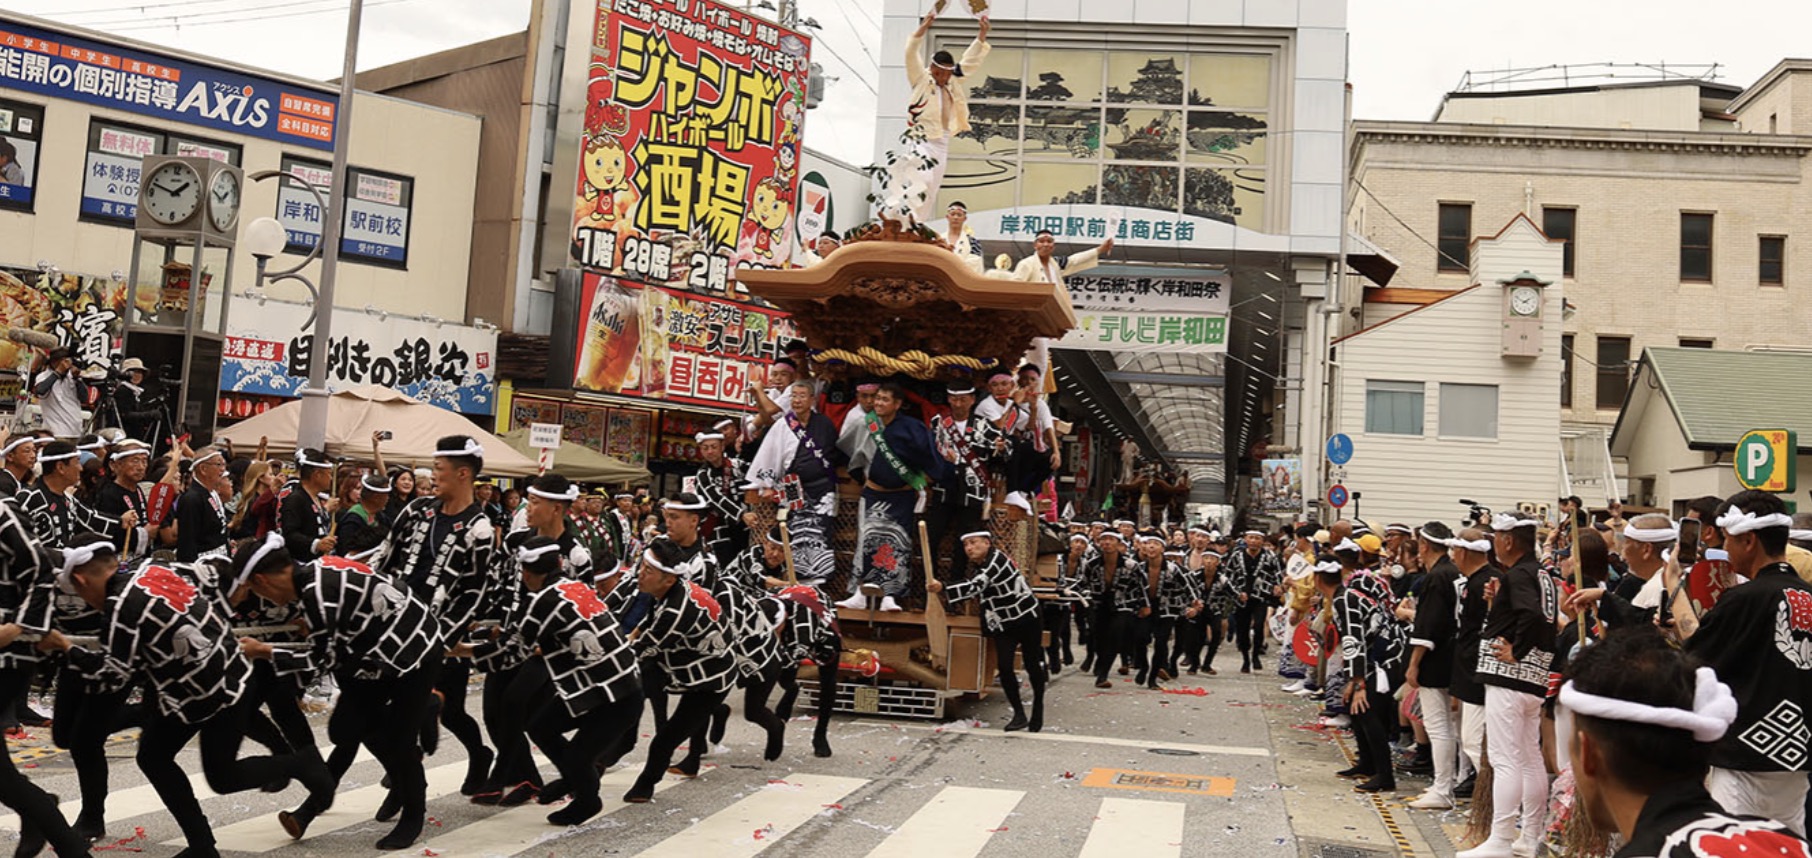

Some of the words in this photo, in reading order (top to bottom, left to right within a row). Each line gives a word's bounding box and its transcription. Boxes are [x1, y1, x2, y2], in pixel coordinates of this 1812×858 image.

[693, 1, 752, 36] ハイボール
[756, 23, 778, 46] 焼酎
[7, 34, 49, 53] 小学生
[70, 49, 112, 65] 中学生
[131, 62, 171, 78] 高校生
[212, 81, 240, 94] アクシス
[616, 30, 785, 143] ジャンボ
[283, 97, 331, 117] 自習席完備
[281, 118, 329, 137] 全科目対応
[650, 113, 745, 149] ハイボール
[102, 131, 152, 154] 無料体
[634, 144, 749, 247] 酒場
[350, 210, 402, 236] 駅前校
[578, 227, 616, 270] 1階
[623, 237, 671, 281] 28席
[688, 252, 729, 292] 2階
[1065, 277, 1221, 299] 史と伝統に輝く岸和田祭
[592, 300, 625, 335] Asahi
[669, 309, 701, 336] 激安
[709, 303, 742, 323] アサヒ
[707, 322, 801, 359] スーパード
[1098, 316, 1226, 345] テレビ岸和田
[669, 355, 745, 404] 昼呑み
[1747, 442, 1769, 480] P
